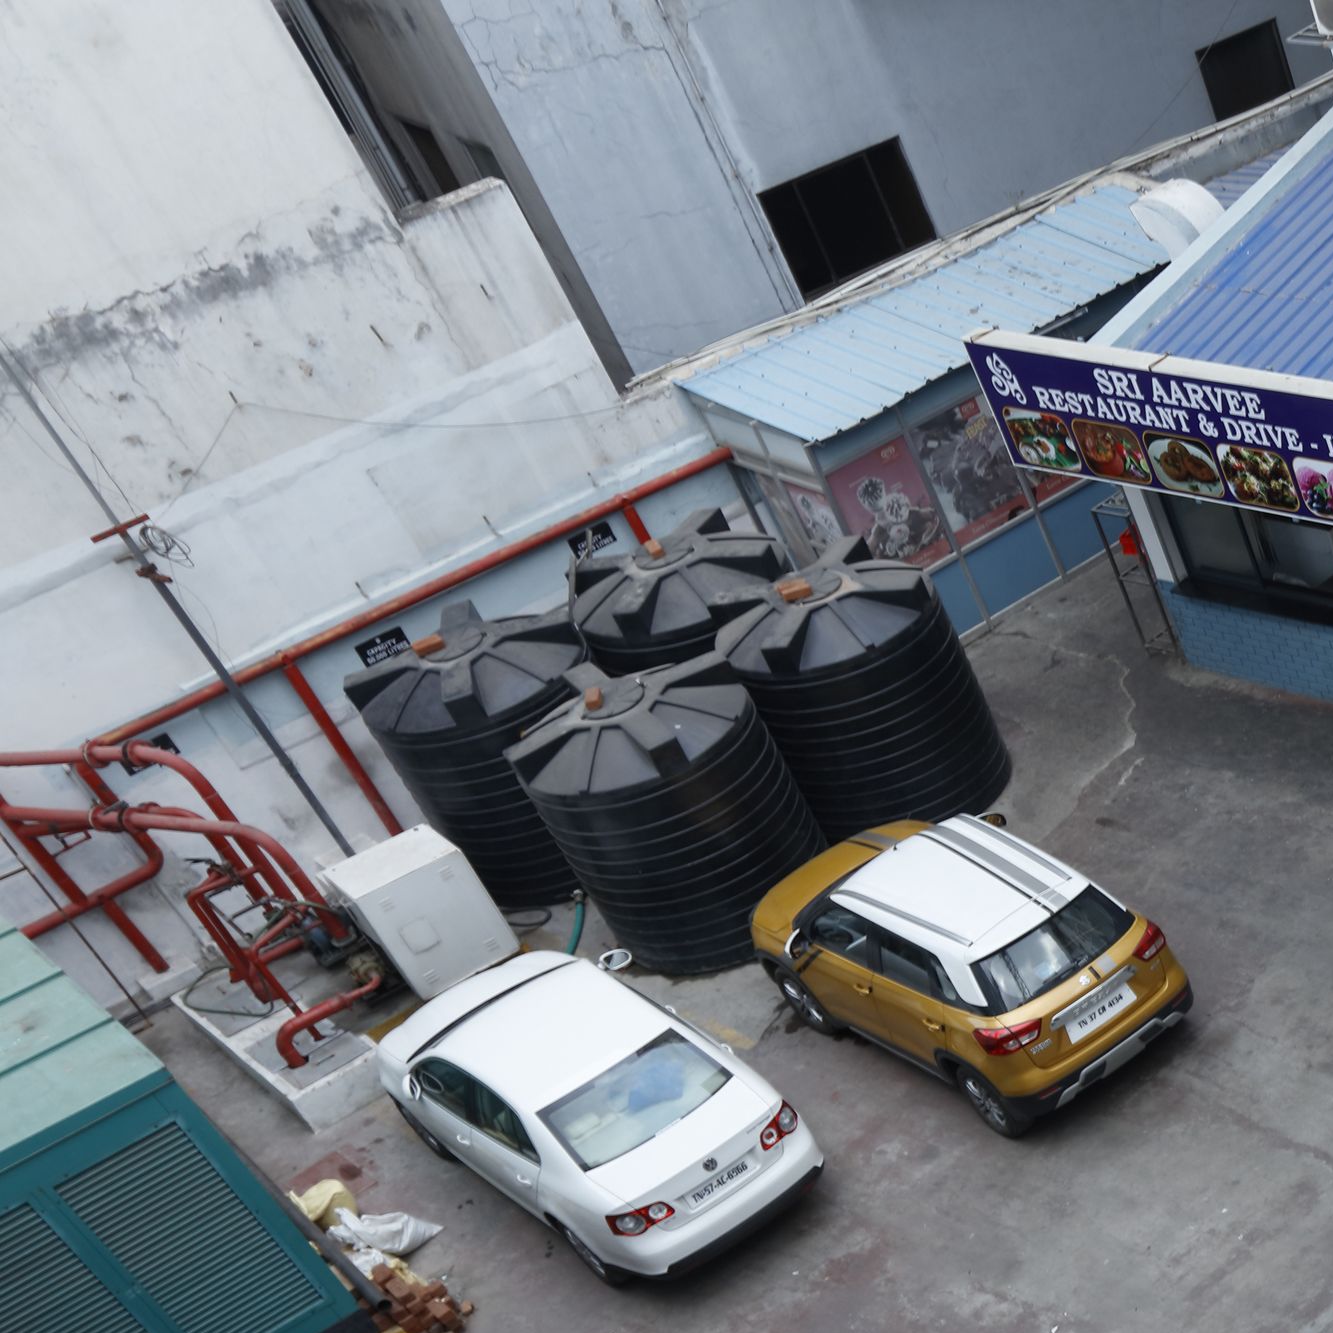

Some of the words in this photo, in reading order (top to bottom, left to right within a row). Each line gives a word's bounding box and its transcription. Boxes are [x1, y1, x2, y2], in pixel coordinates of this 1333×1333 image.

[1031, 386, 1190, 433] RESTAURANT
[1197, 412, 1219, 438] &
[1221, 417, 1303, 452] DRIVE
[1093, 368, 1143, 401] SRI
[1152, 380, 1266, 421] AARVEE
